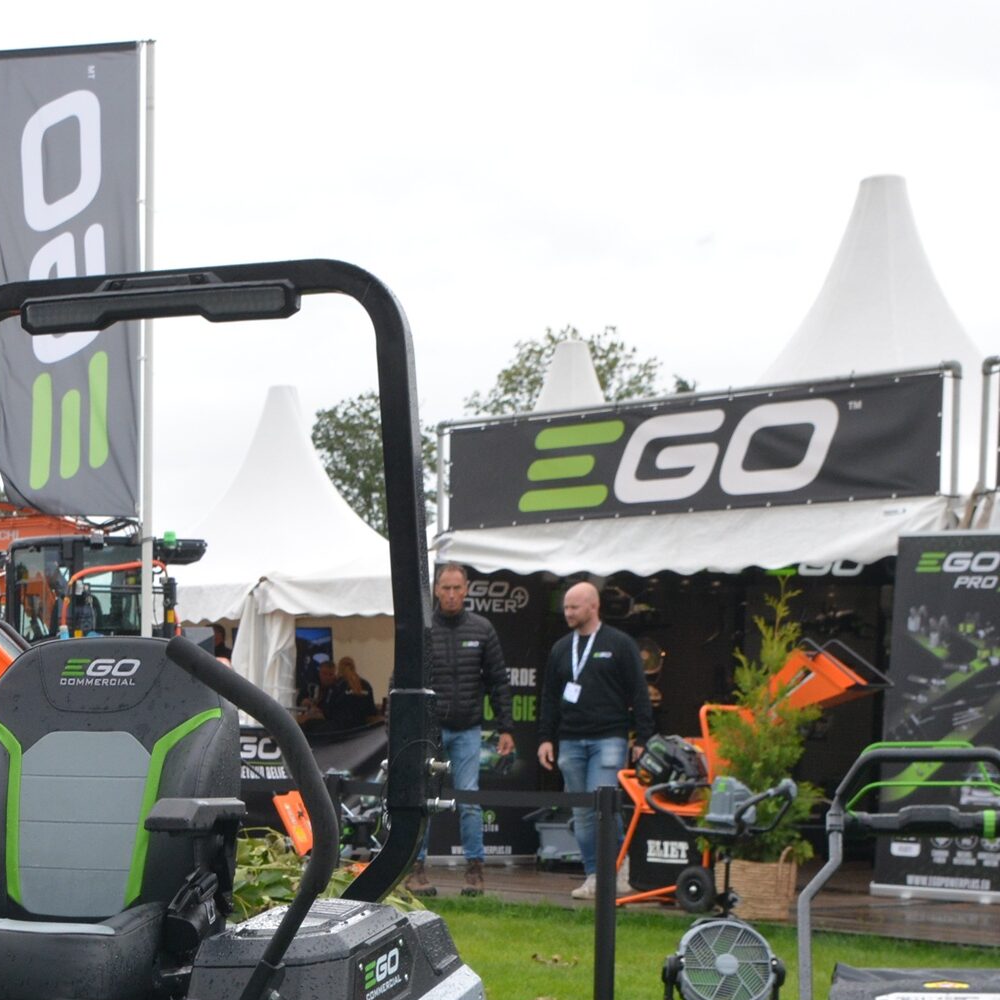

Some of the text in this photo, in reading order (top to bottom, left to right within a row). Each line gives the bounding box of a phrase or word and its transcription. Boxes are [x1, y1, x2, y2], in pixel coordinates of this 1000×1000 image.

[518, 398, 840, 513] EGO
[914, 550, 1000, 574] EGO
[466, 580, 511, 598] GO
[953, 575, 1000, 590] PRO
[464, 597, 518, 613] OWER
[61, 658, 142, 677] EGO
[60, 678, 136, 687] COMMERCIAL
[646, 839, 690, 859] ELIET
[364, 947, 400, 990] EGO
